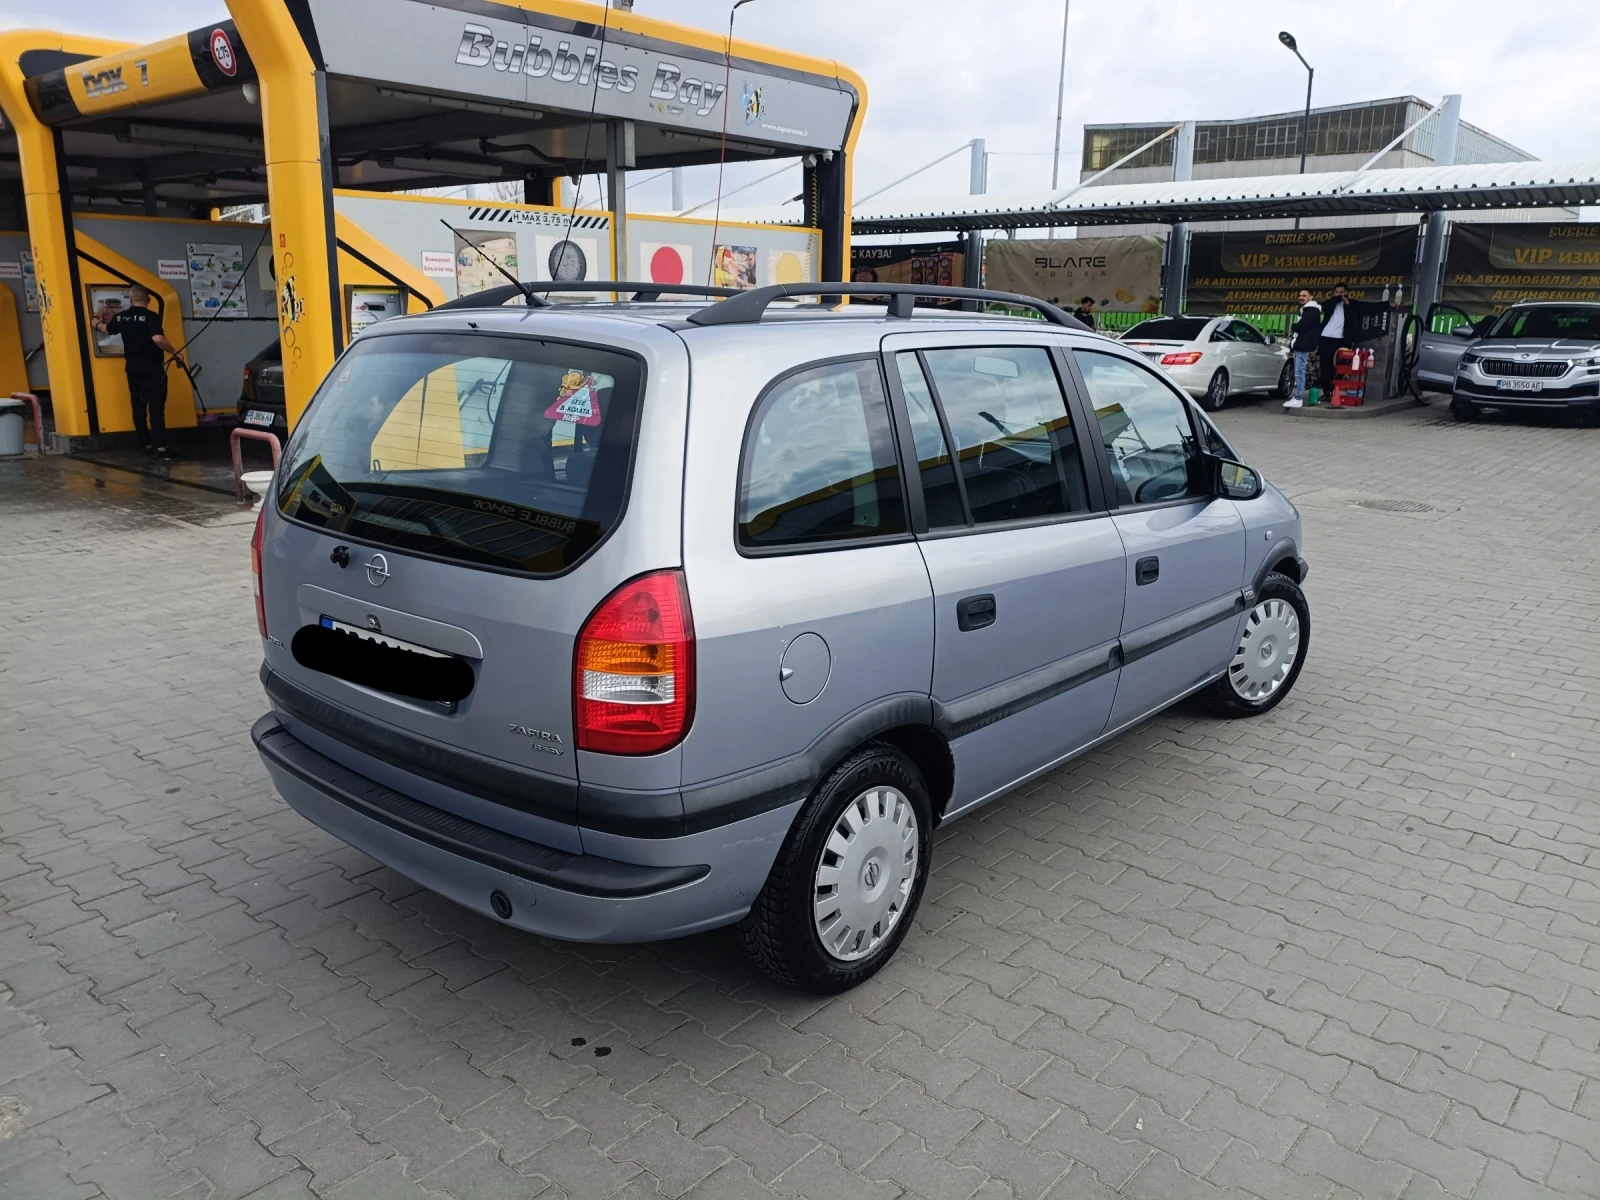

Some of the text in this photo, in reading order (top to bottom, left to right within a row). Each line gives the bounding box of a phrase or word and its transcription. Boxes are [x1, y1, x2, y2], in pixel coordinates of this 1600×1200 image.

[455, 22, 727, 117] Bubbles Bay
[81, 66, 129, 99] box
[513, 213, 519, 221] H
[522, 214, 541, 222] MAX
[543, 215, 561, 224] 3.75
[1265, 232, 1335, 244] BUBBLE SHOP
[859, 248, 892, 259] КАУЗА!
[1514, 248, 1553, 264] VIP
[1240, 254, 1358, 268] VIP ИЗМИВАНЕ
[1195, 278, 1209, 286] НА
[1349, 276, 1358, 285] И
[1360, 275, 1404, 285] БУСОВЕ
[1454, 274, 1472, 283] НА
[1225, 290, 1300, 301] ДЕЗИНФЕКЦИ
[1325, 290, 1365, 299] СОН
[1491, 290, 1596, 300] ДЕЗИНФЕКЦИЯ
[1226, 304, 1298, 313] ПАСТИРАНЕ И
[509, 723, 564, 745] ZAFIRA
